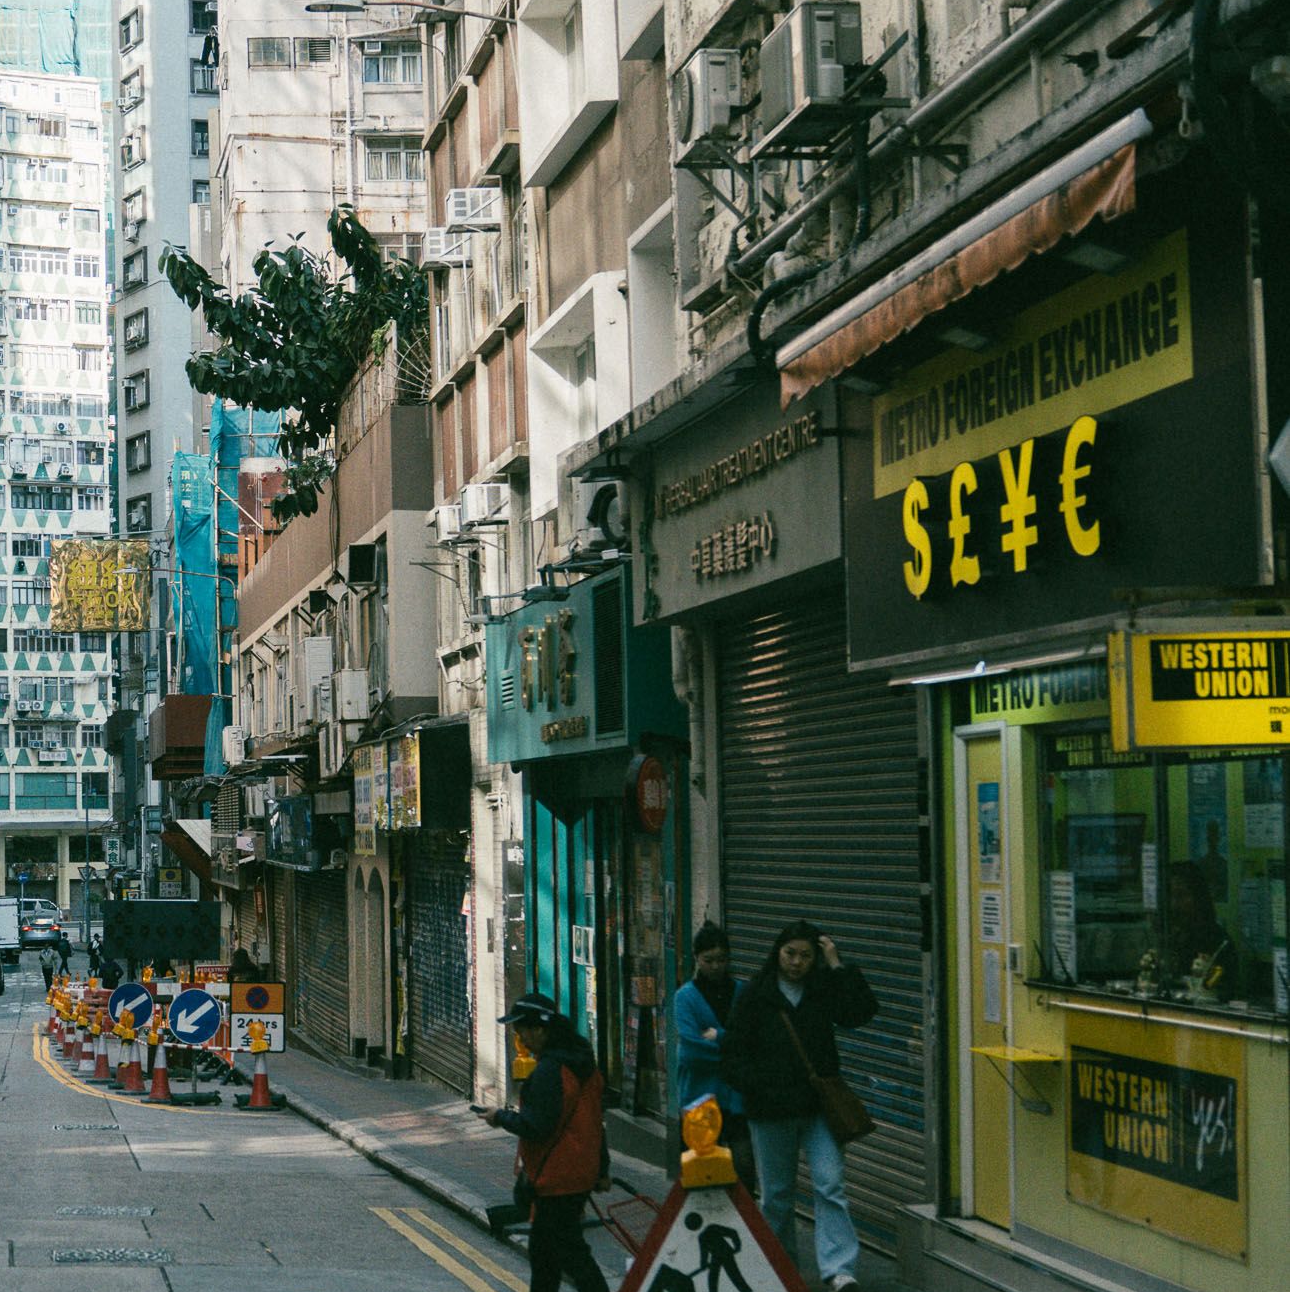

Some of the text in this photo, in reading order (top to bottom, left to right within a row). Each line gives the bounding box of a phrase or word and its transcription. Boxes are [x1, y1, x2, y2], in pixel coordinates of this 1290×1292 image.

[880, 272, 1179, 468] METRO FOREIGN EXCHANGE
[717, 433, 774, 488] TREATMENT
[774, 411, 817, 460] CENTRE
[1160, 642, 1269, 669] WESTERN
[974, 661, 1109, 715] METRO FOREIG
[1195, 670, 1270, 697] UNION
[107, 839, 119, 864] 素食
[1077, 1062, 1168, 1119] WESTERN
[1104, 1109, 1168, 1164] UNION
